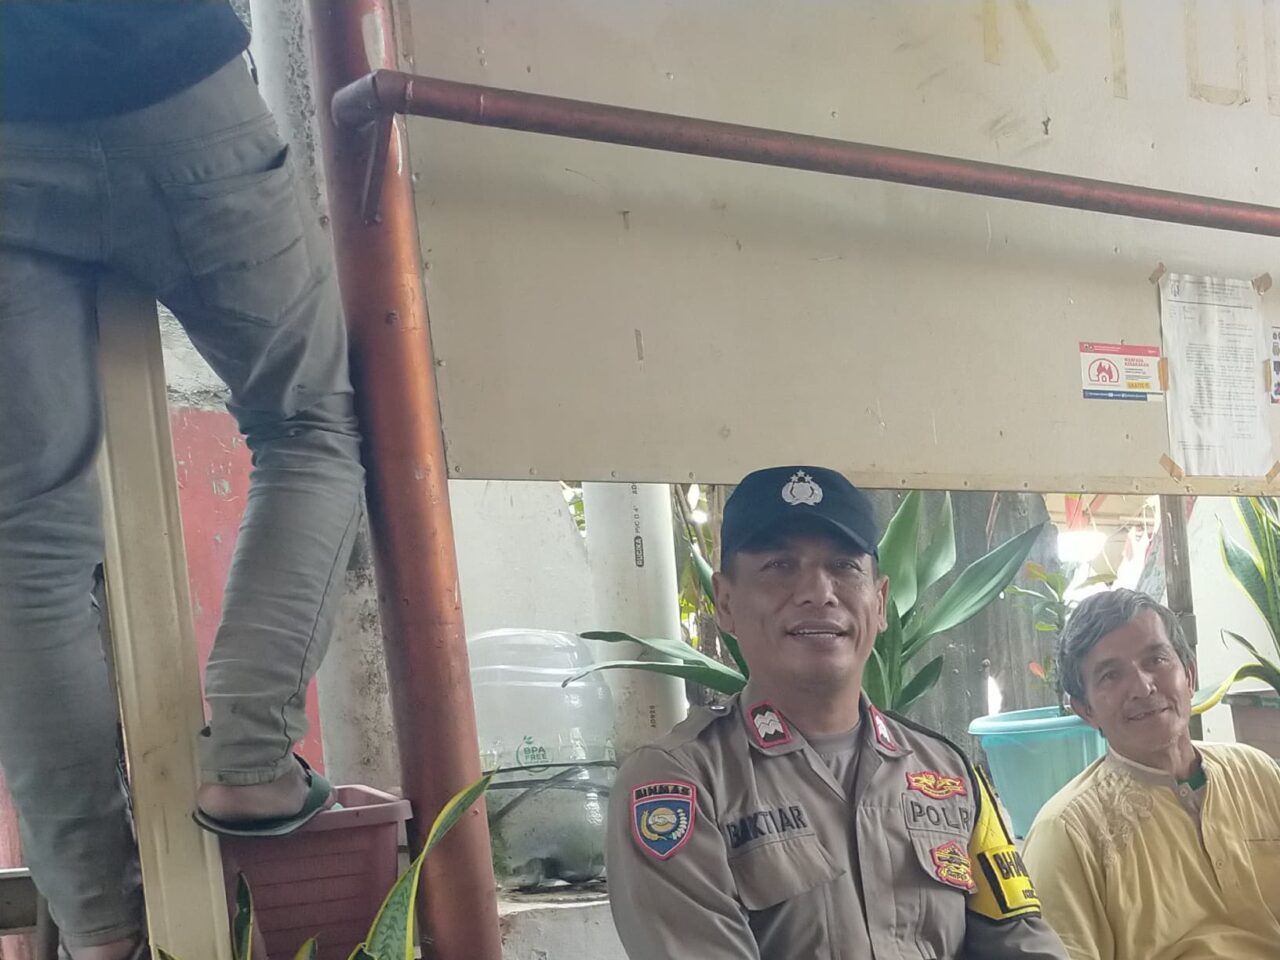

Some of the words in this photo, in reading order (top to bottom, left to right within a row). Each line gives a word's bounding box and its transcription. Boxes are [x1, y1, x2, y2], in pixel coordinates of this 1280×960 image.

[523, 746, 546, 754] BPA
[525, 753, 547, 761] FREE
[910, 800, 970, 832] POLR
[726, 805, 807, 849] BAKTIAR
